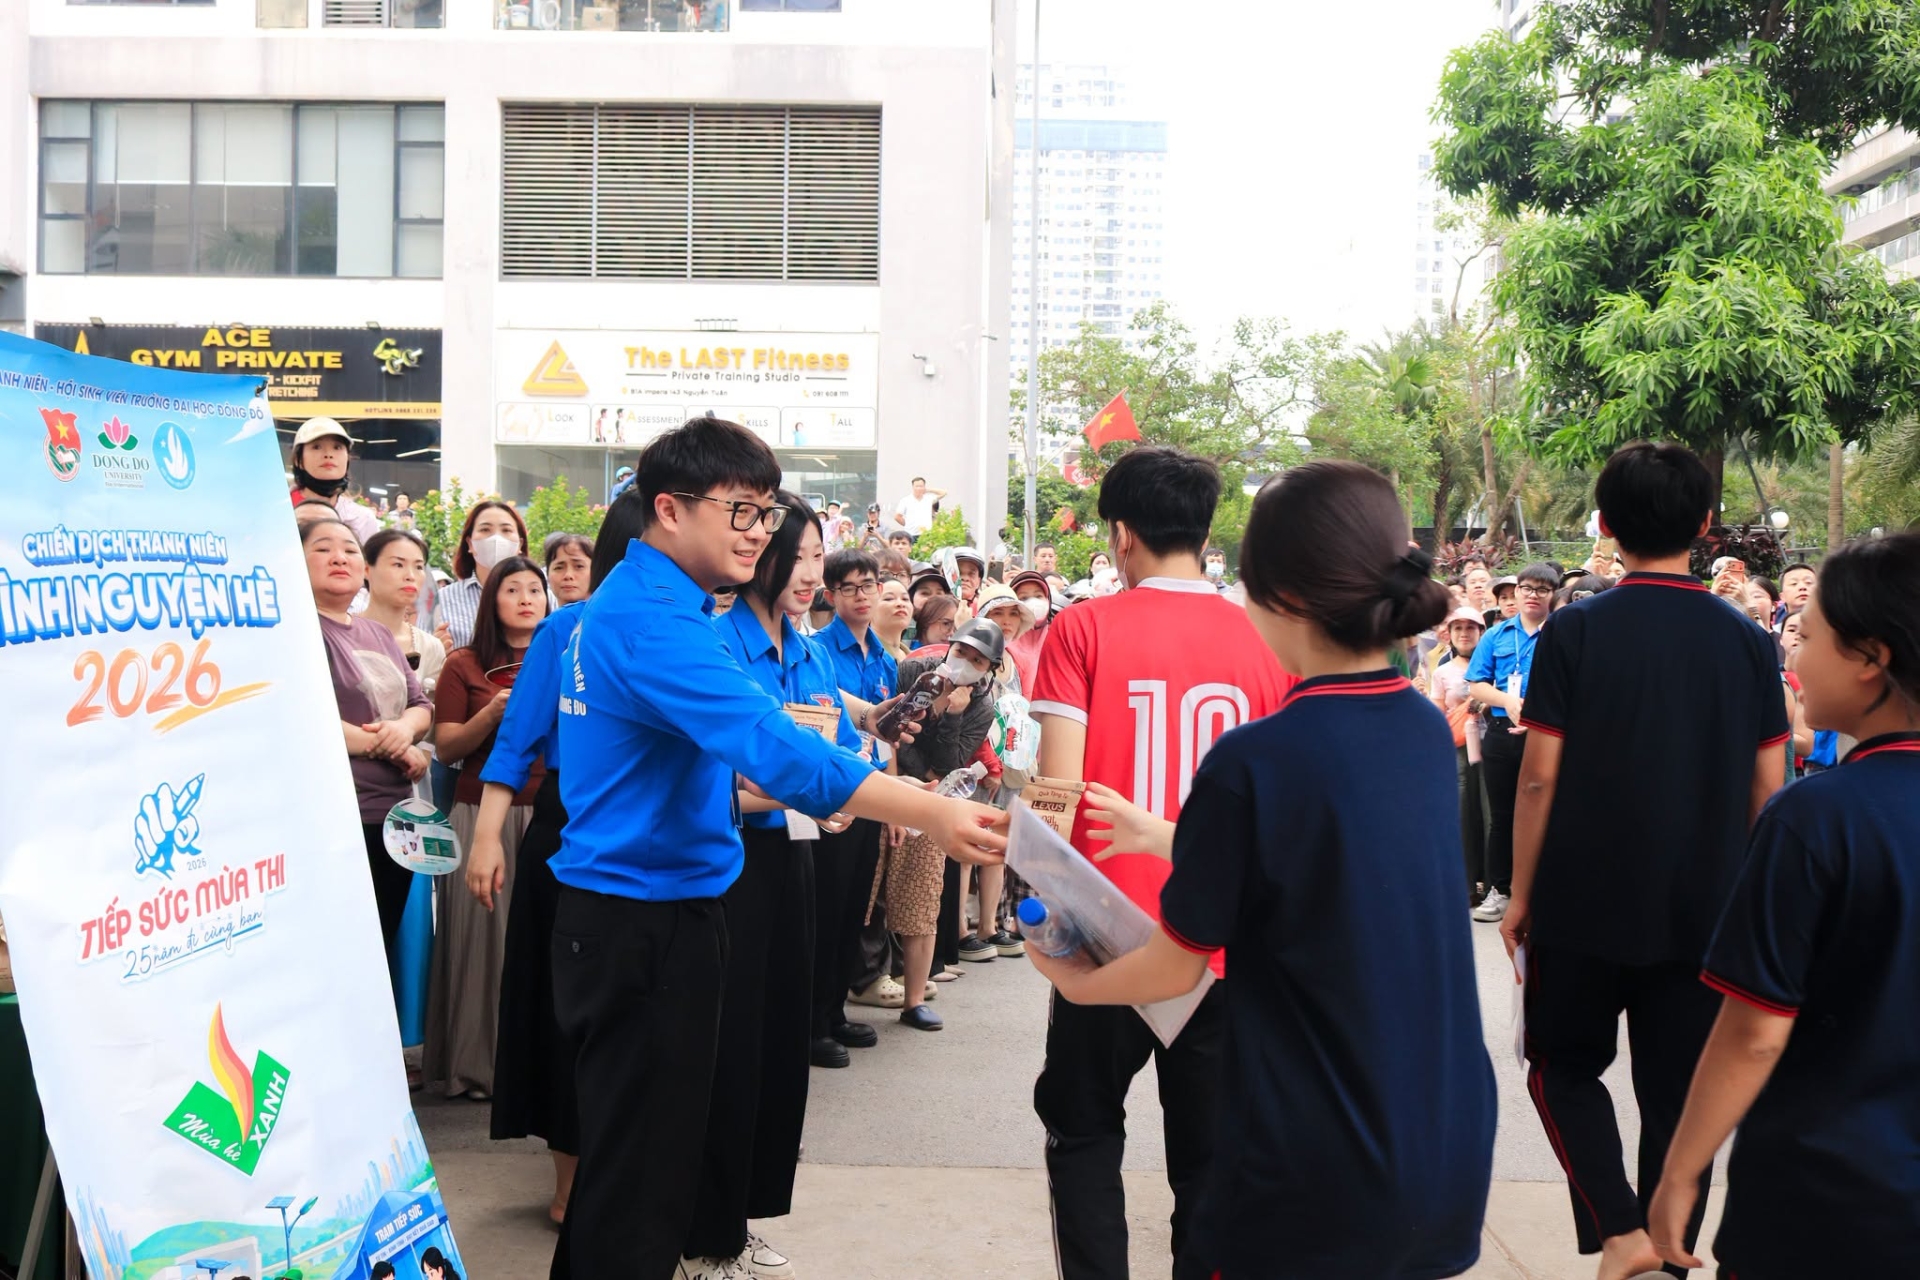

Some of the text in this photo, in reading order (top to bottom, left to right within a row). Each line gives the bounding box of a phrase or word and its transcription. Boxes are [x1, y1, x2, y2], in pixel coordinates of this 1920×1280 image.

[201, 327, 271, 347] ACE
[131, 349, 343, 368] GYM PRIVATE
[624, 346, 850, 370] The LAST Fitness
[671, 371, 800, 382] Private Training Studio
[24, 374, 48, 392] NIÊN
[57, 380, 77, 399] HỘI
[80, 386, 104, 400] SINH
[173, 399, 190, 416] ĐẠI
[193, 403, 215, 418] HỌC
[217, 402, 247, 418] ĐÔNG
[93, 454, 150, 471] DONG DO
[104, 471, 143, 481] UNIVERSITY
[23, 524, 228, 567] CHIẾN DỊCH THANH NIÊN
[73, 562, 232, 638] NGUYỆN
[231, 566, 280, 626] HÈ
[66, 638, 221, 727] 2026
[1128, 679, 1250, 820] 10
[1032, 801, 1064, 812] LEXUS
[186, 858, 207, 871] 2026
[81, 854, 285, 959] TIẾP SỨC MÙA THI
[248, 1071, 286, 1150] XANH
[178, 1113, 242, 1161] Mùa hè
[375, 1222, 395, 1244] TRẠM
[393, 1211, 408, 1231] TIẾP
[408, 1204, 423, 1221] SỨC
